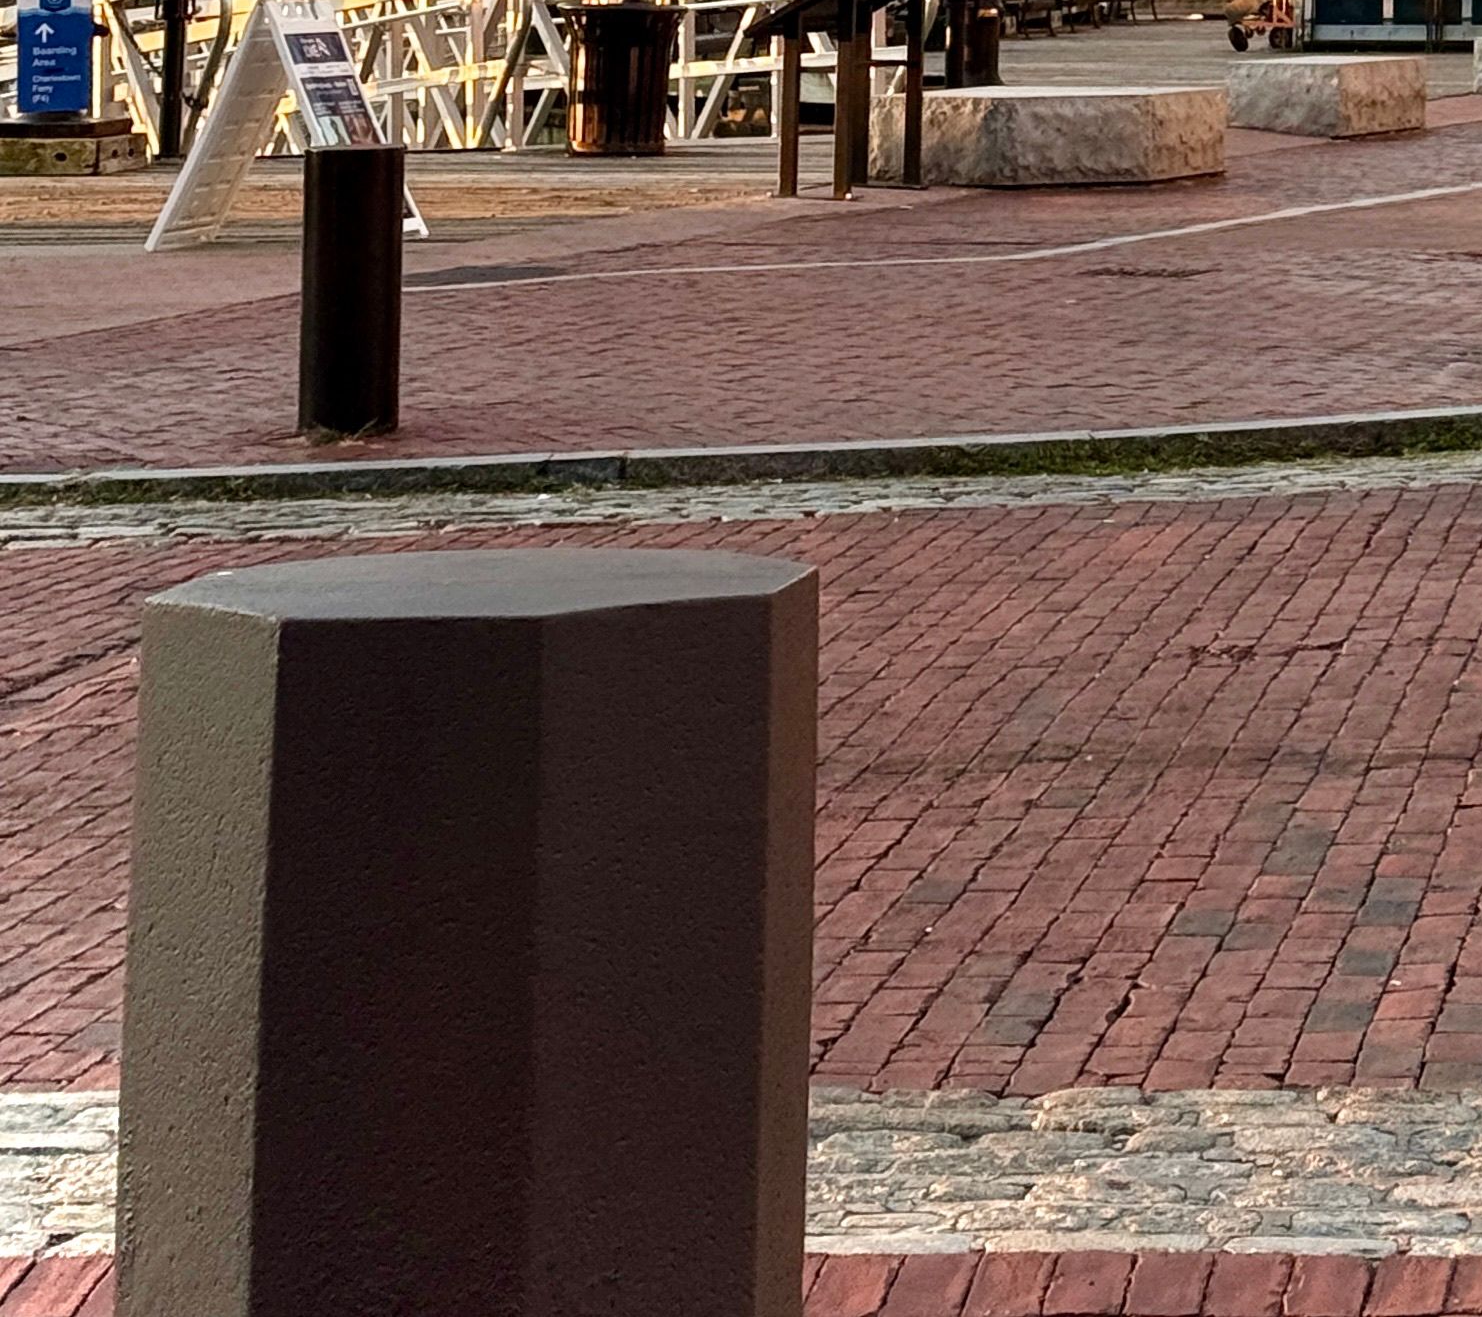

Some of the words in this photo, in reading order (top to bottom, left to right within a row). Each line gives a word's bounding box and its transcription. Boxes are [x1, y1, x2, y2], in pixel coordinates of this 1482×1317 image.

[32, 46, 77, 56] Boarding
[32, 58, 56, 67] Area
[32, 84, 53, 93] Ferry
